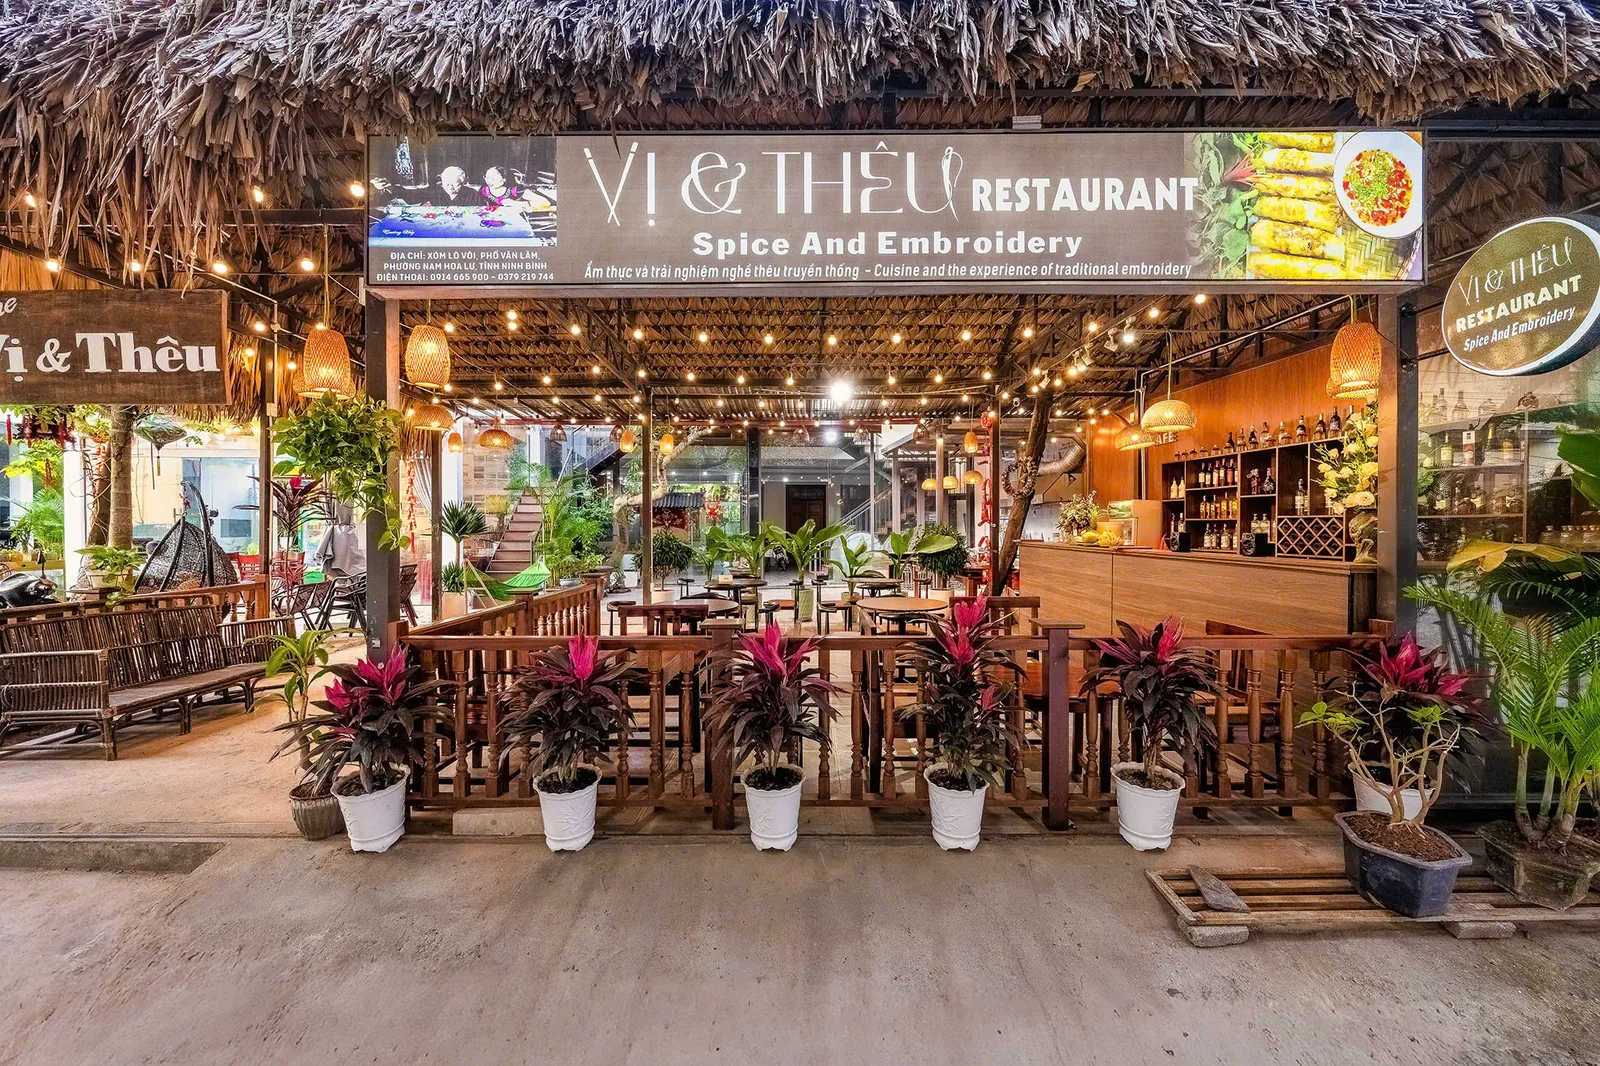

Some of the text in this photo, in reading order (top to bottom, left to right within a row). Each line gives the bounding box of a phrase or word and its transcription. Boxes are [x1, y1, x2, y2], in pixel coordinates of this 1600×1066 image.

[584, 141, 1198, 226] VỊ & THÊU RESTAURANT
[391, 252, 406, 261] ĐỊA
[428, 251, 446, 260] XÓM
[449, 251, 459, 260] LÒ
[693, 231, 1082, 259] Spice And Embroidery
[376, 272, 398, 282] ĐIỆN
[400, 273, 428, 282] THOẠI:
[430, 273, 451, 281] 0914
[454, 273, 470, 281] 665
[472, 273, 488, 281] 900
[526, 261, 547, 269] BÌNH
[584, 261, 603, 279] Ẩm
[606, 266, 633, 280] thực
[635, 266, 648, 279] và
[650, 264, 671, 279] trải
[674, 264, 719, 283] nghiệm
[722, 262, 751, 282] nghề
[754, 264, 781, 278] thêu
[784, 263, 825, 281] truyền
[824, 262, 859, 280] thống
[874, 264, 919, 276] Cuisine
[923, 263, 944, 276] and
[948, 263, 966, 276] the
[969, 263, 1037, 278] experience
[1040, 262, 1053, 276] of
[1055, 262, 1118, 275] traditional
[1121, 262, 1191, 278] embroidery
[1458, 237, 1572, 306] VỊ & THÊU
[1456, 275, 1581, 332] RESTAURANT
[1464, 306, 1576, 351] Spice And Embroidery
[36, 338, 71, 372] &
[76, 332, 220, 372] Thêu
